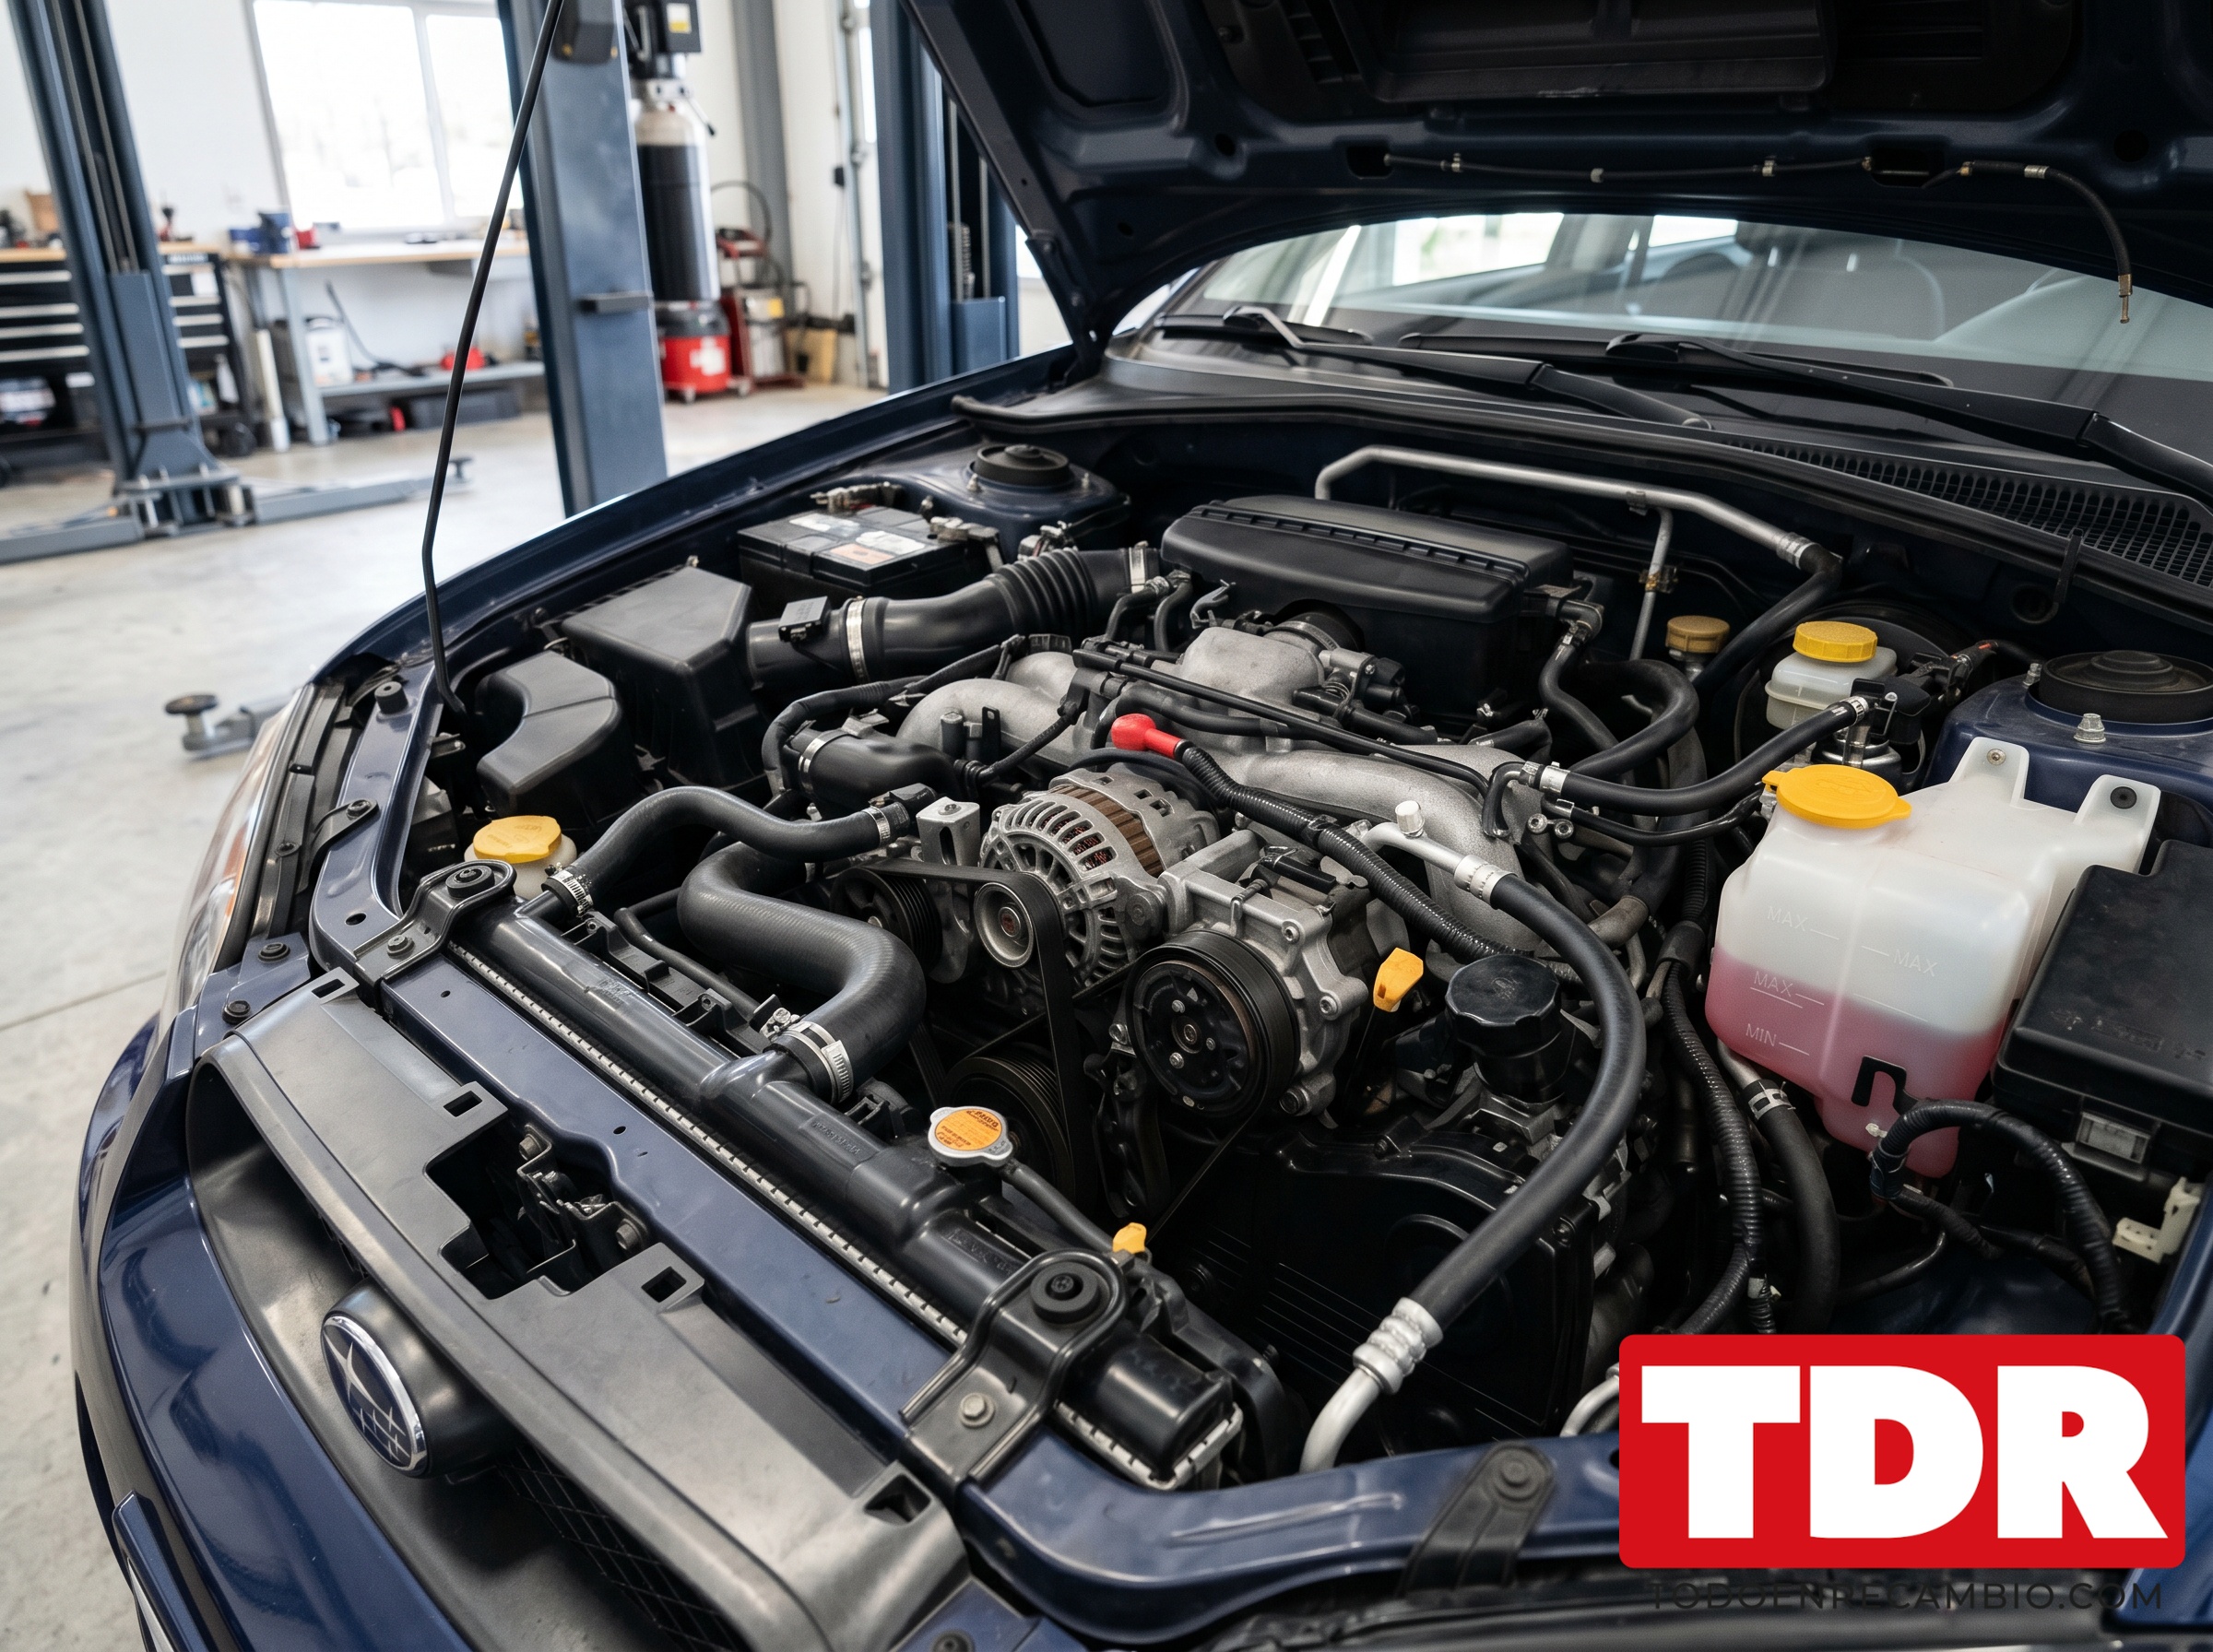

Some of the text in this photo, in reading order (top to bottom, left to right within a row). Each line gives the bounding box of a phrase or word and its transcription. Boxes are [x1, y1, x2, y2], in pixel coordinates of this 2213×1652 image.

[1767, 906, 1808, 931] MAX
[1893, 949, 1937, 977] MAX
[1754, 971, 1793, 997] MAX
[1746, 1023, 1778, 1047] MIN
